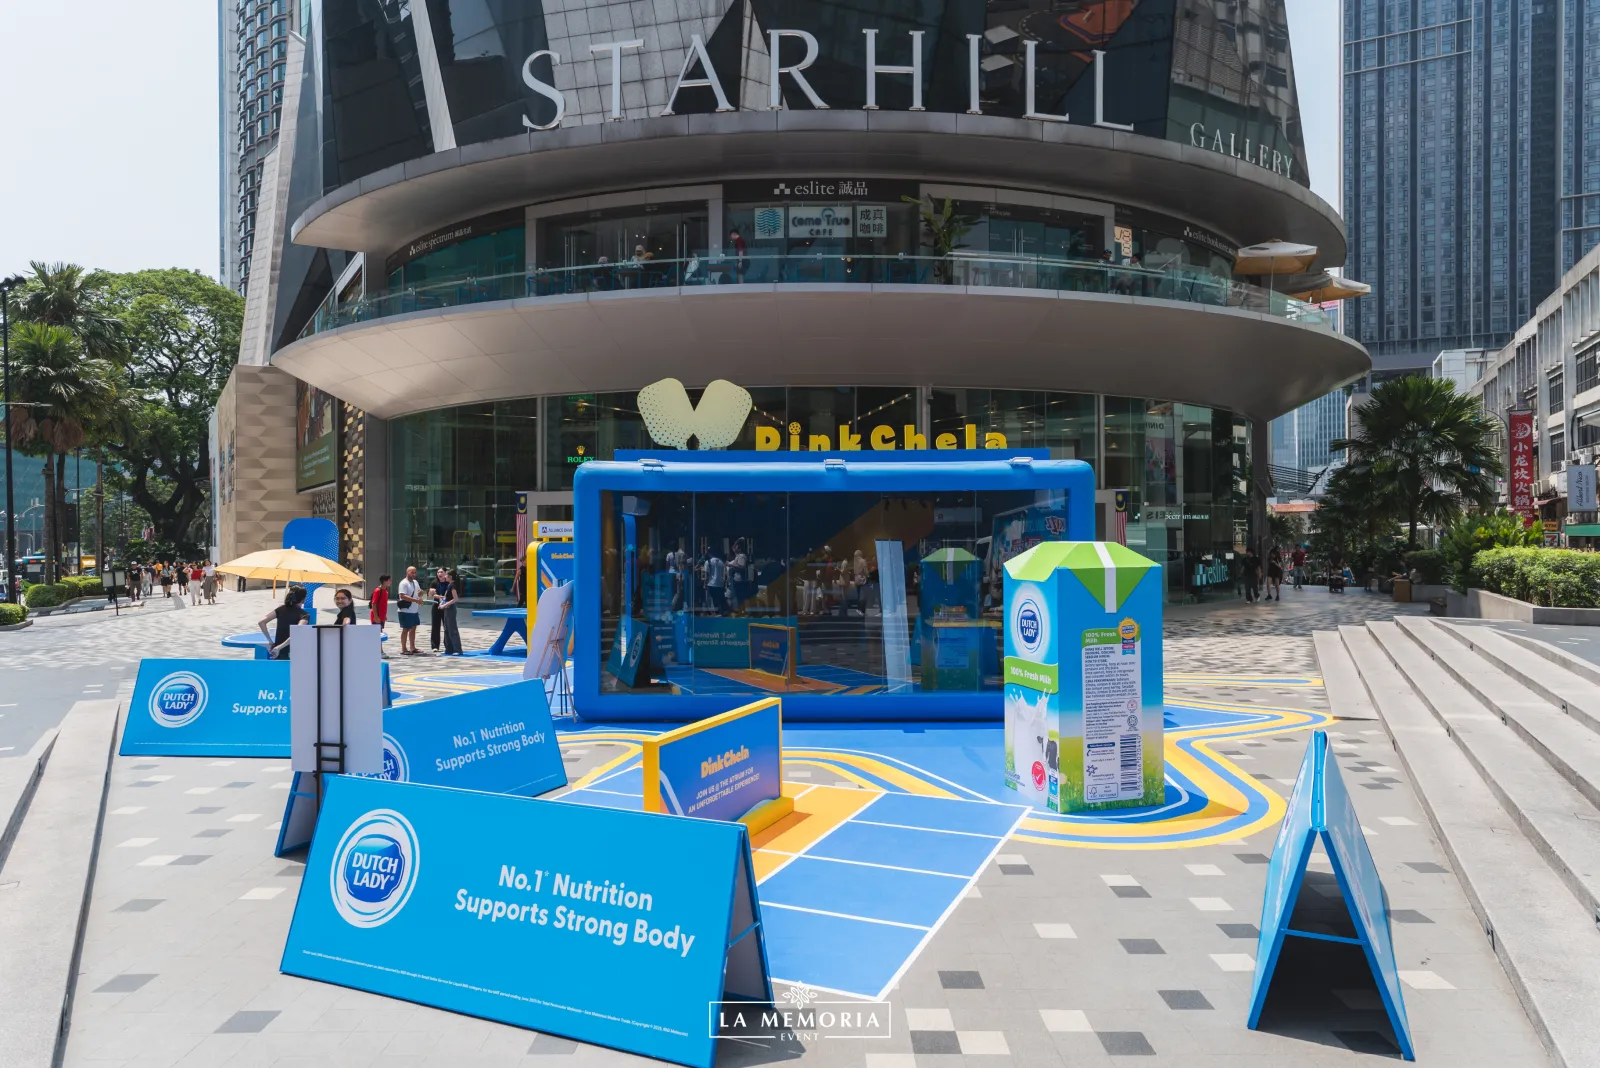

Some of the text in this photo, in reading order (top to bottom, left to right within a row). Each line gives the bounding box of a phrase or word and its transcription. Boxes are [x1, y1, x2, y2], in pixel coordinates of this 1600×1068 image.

[522, 29, 1134, 131] STARHILL
[1190, 122, 1292, 178] GALLERY
[794, 181, 835, 195] eslite
[838, 181, 868, 196] 誠品
[792, 214, 850, 227] Come True
[755, 421, 1008, 452] DinkChela
[1513, 442, 1531, 506] 小龙坎火锅
[1208, 558, 1228, 584] eslite
[1022, 619, 1038, 629] DUTCH
[1024, 628, 1036, 638] LADY
[1010, 666, 1052, 684] 100% Fresh Milk
[163, 692, 194, 702] DUTCH
[165, 701, 190, 710] LADY
[232, 703, 288, 716] Supports
[480, 720, 525, 742] Nutrition
[436, 732, 546, 772] Supports Strong Body
[701, 745, 750, 778] DinkChela
[696, 789, 708, 800] JOIN
[708, 785, 715, 796] US
[720, 778, 728, 788] THE
[729, 771, 745, 785] ATRIUM
[746, 766, 754, 777] FOR
[688, 805, 696, 814] AN
[696, 786, 734, 810] UNFORGETTABLE
[352, 852, 398, 874] DUTCH
[353, 870, 391, 890] LADY
[552, 872, 652, 911] Nutrition
[454, 888, 696, 958] Supports Strong Body
